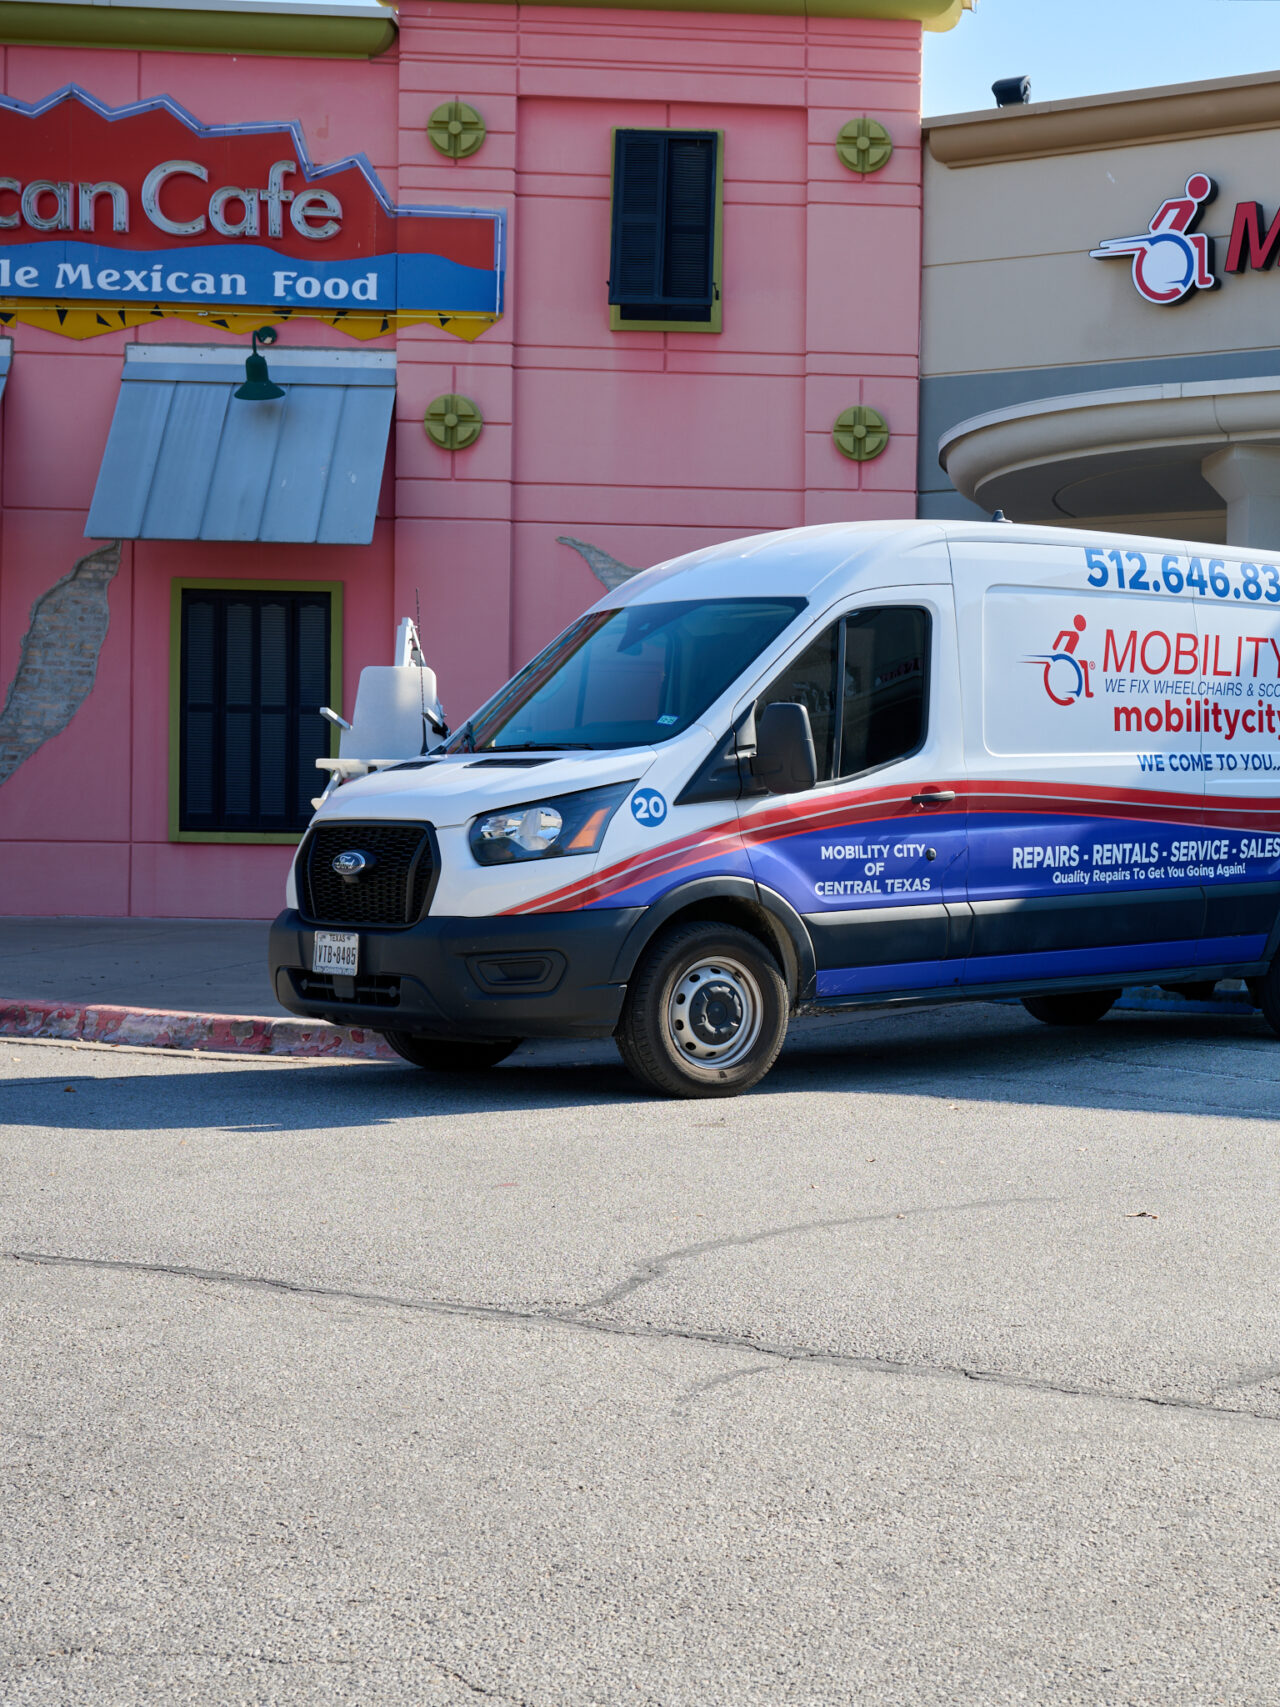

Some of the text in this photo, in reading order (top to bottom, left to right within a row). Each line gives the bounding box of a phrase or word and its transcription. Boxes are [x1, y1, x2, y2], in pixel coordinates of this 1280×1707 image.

[141, 159, 343, 240] Cafe
[55, 263, 247, 296] Mexican
[273, 271, 378, 300] Food
[1104, 678, 1126, 693] WE
[1130, 679, 1150, 694] FIX
[1153, 680, 1243, 696] WHEELCHAIRS
[1246, 683, 1255, 696] &
[1137, 755, 1164, 771] WE
[1169, 754, 1213, 771] COME
[1214, 754, 1237, 770] TO
[634, 796, 664, 818] 20
[821, 844, 925, 860] MOBILITY CITY
[1012, 846, 1079, 869] REPAIRS
[1092, 843, 1159, 865] RENTALS
[1171, 840, 1229, 862] SERVICE
[1240, 838, 1280, 858] SALES
[864, 862, 885, 876] OF
[1053, 863, 1246, 885] Quality Repairs To Get You Going Again!
[814, 878, 931, 895] CENTRAL TEXAS
